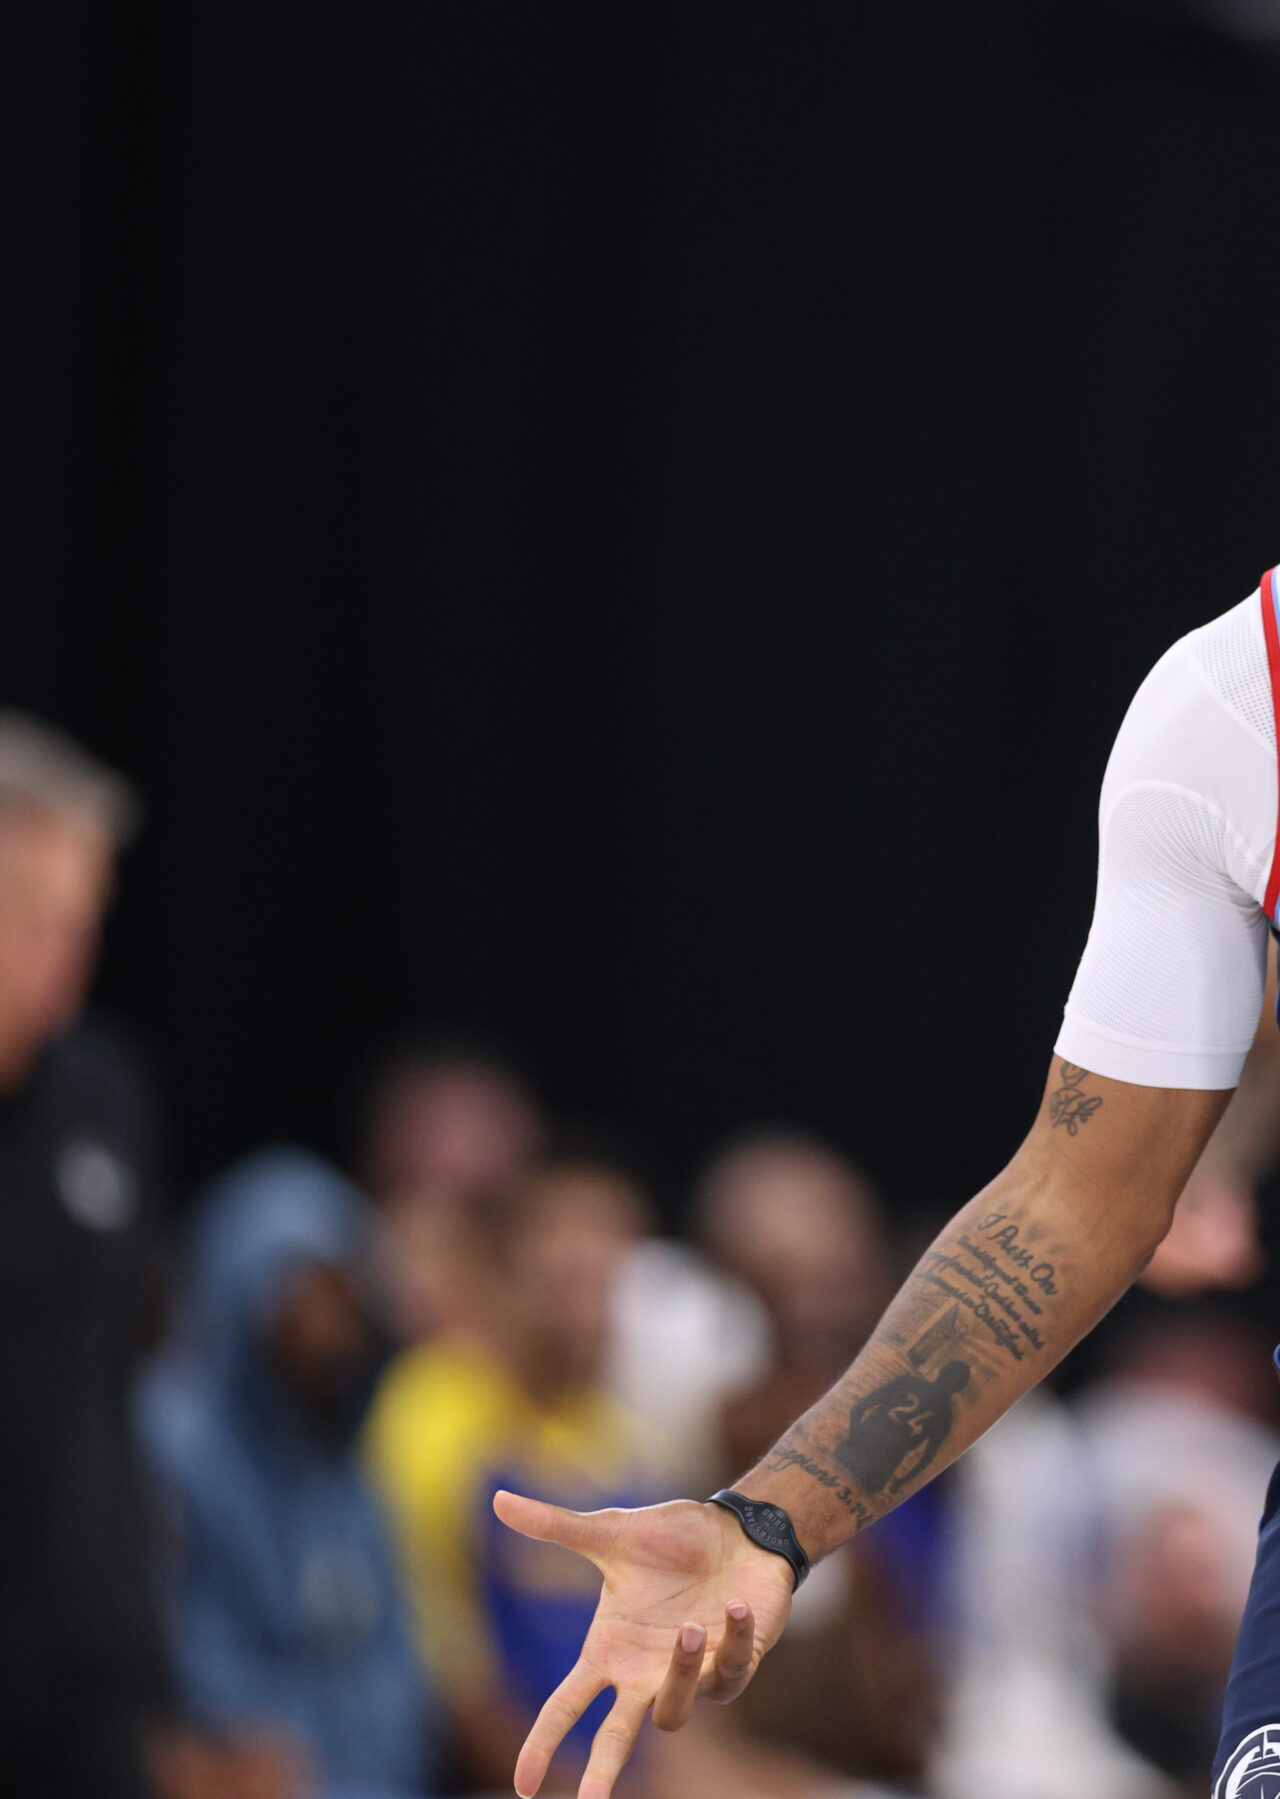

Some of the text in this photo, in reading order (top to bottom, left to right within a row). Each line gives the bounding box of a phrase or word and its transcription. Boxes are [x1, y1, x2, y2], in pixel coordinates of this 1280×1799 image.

[986, 1225, 1034, 1268] Press
[1030, 1263, 1058, 1295] On
[888, 1393, 933, 1437] 24
[744, 1506, 790, 1546] UNDERSTAND
[762, 1508, 787, 1530] GRIND
